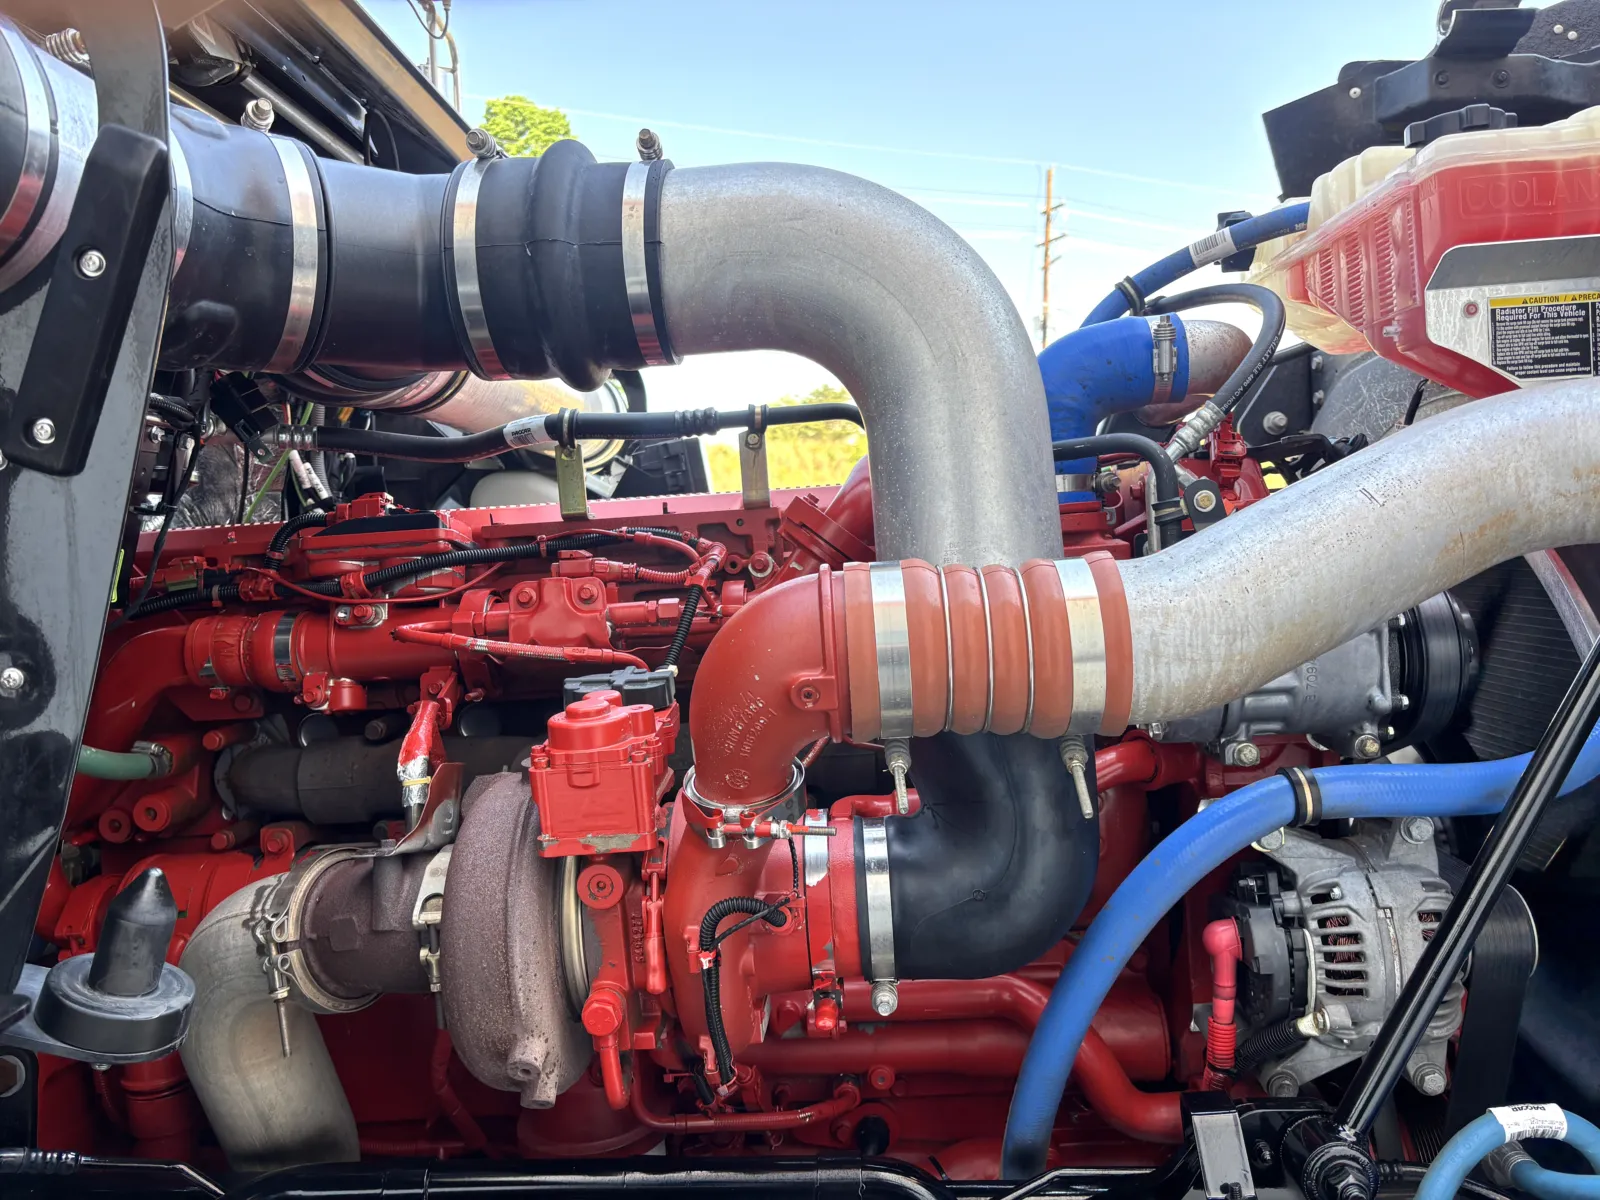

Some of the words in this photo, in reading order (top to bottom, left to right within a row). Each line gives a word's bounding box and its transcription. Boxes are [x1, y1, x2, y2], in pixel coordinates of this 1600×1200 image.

[1528, 296, 1560, 304] CAUTION
[1496, 307, 1525, 316] Radiator
[1540, 304, 1576, 312] Procedure
[1496, 313, 1527, 322] Required
[1560, 309, 1586, 317] Vehicle
[1220, 395, 1236, 412] HOSE
